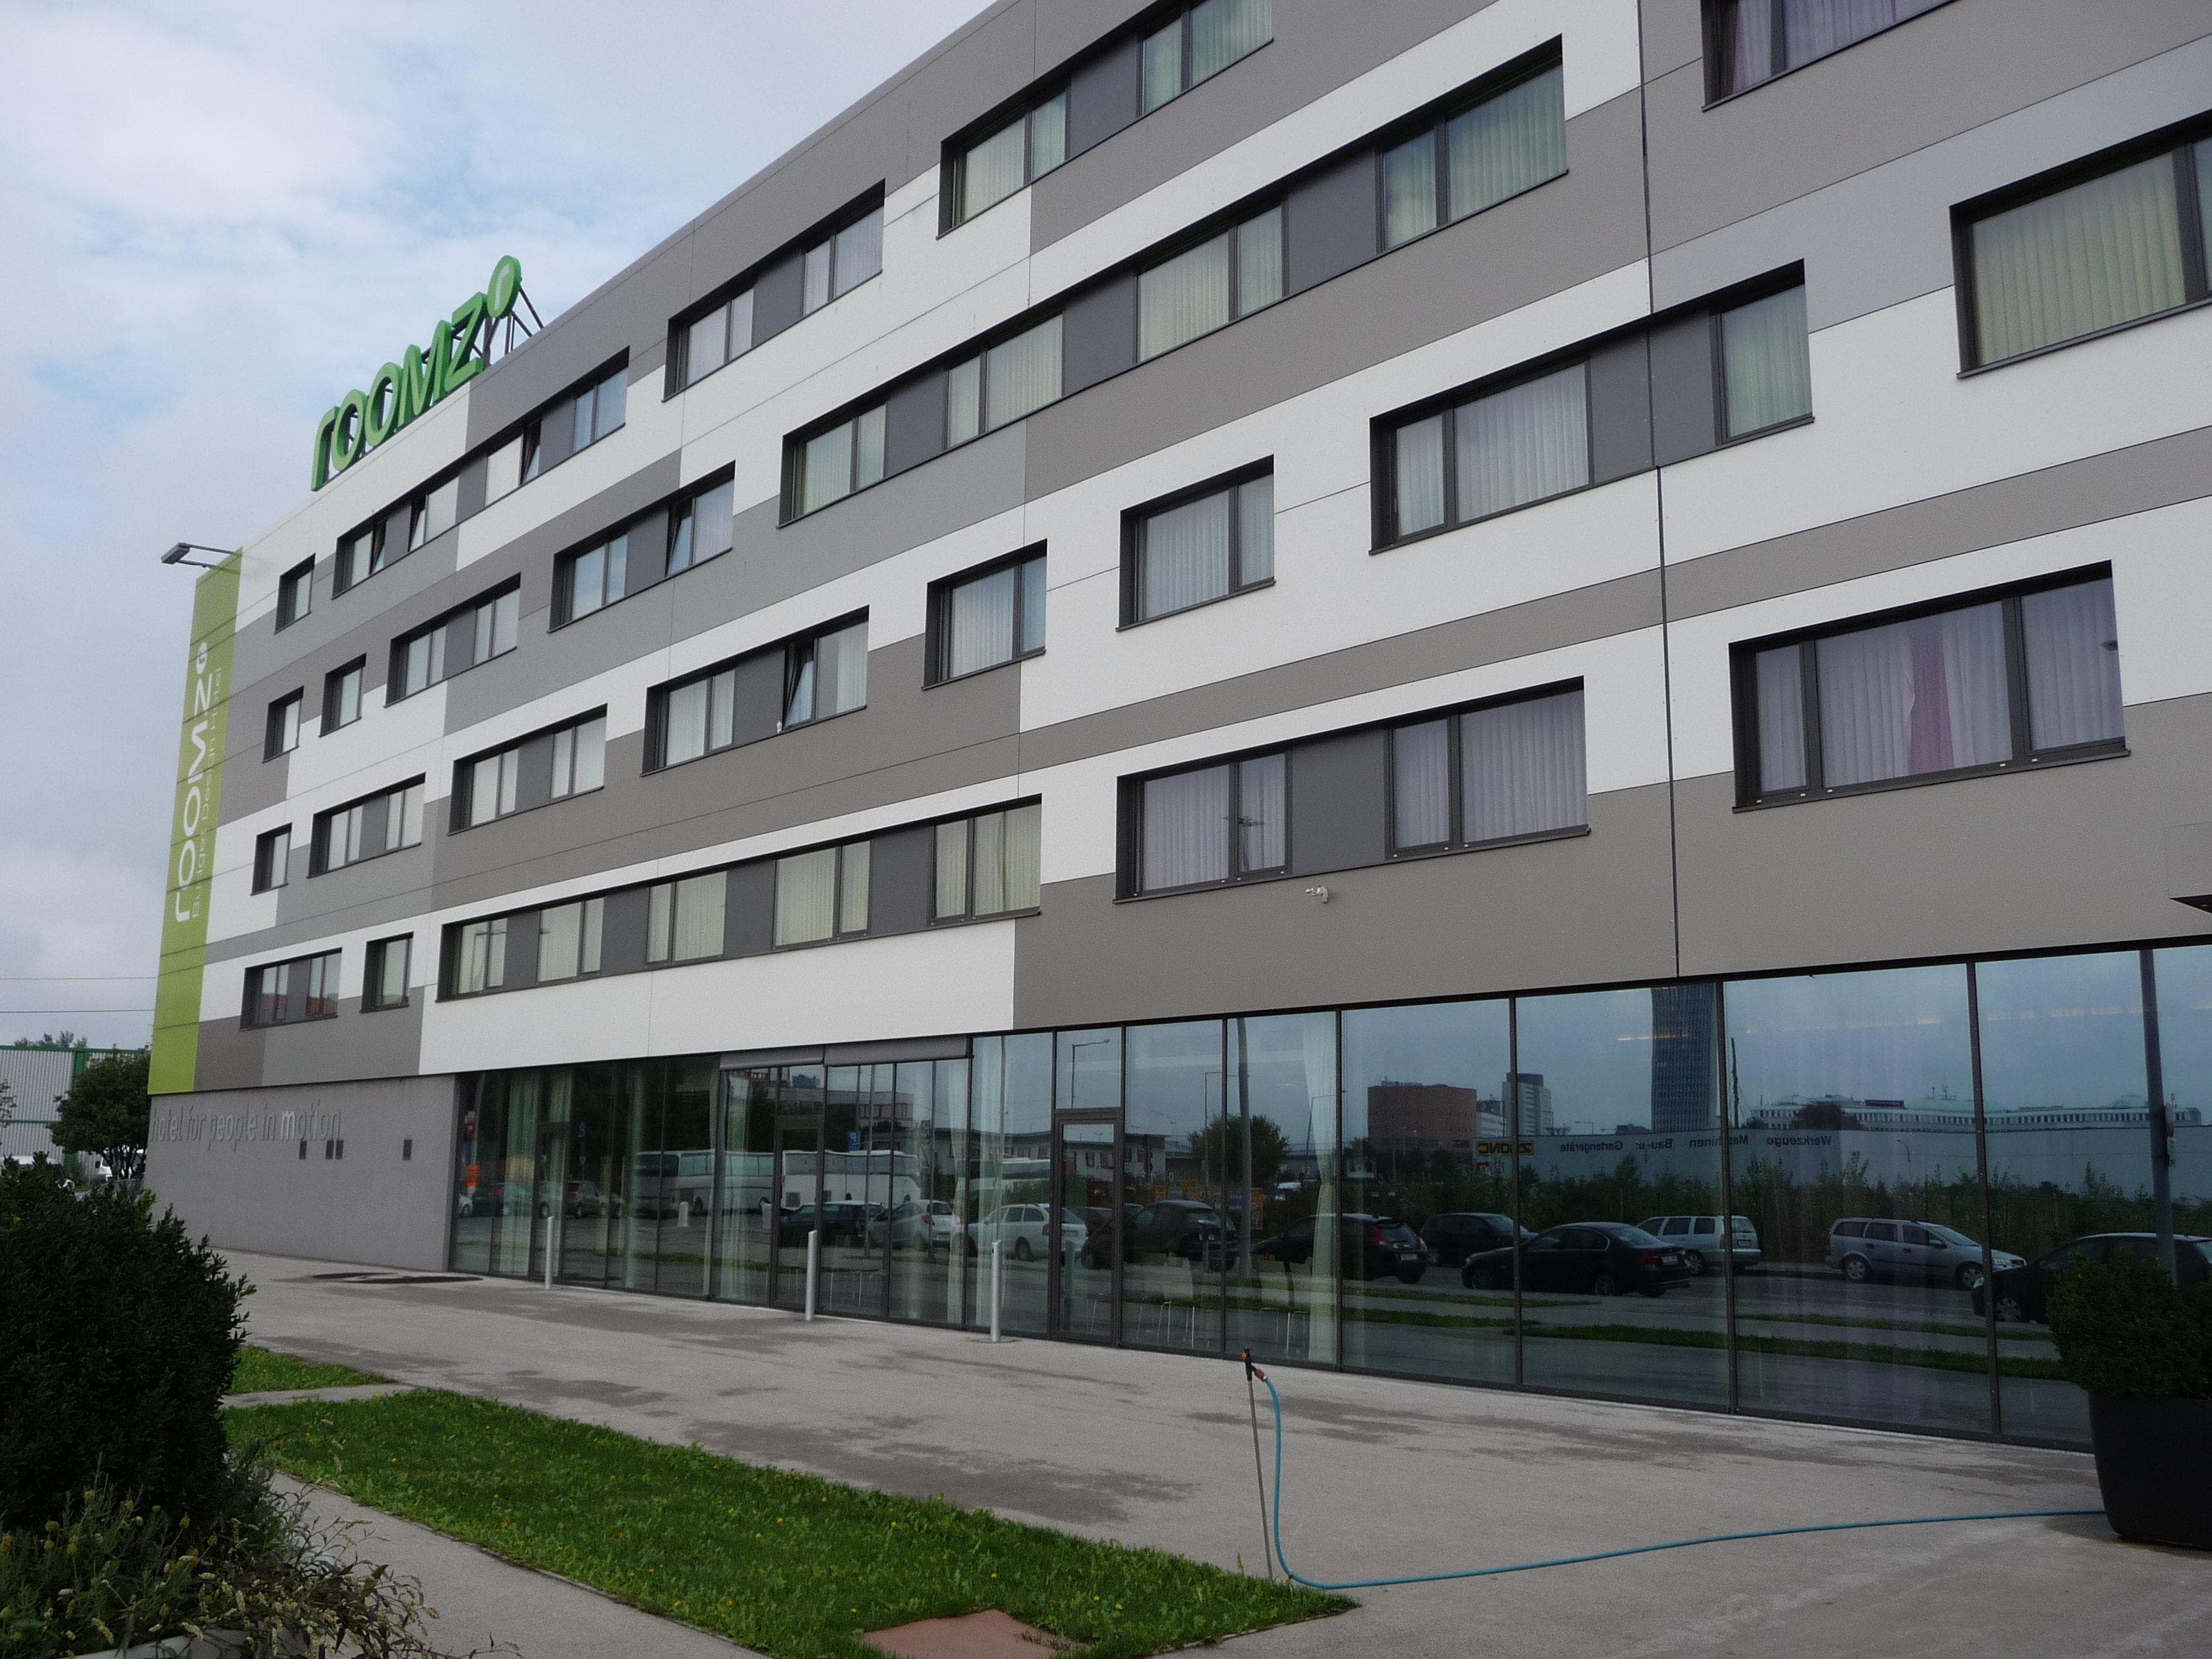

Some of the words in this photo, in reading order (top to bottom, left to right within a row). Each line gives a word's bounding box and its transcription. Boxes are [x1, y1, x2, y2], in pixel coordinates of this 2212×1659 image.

[150, 1105, 183, 1142] hotel
[188, 1105, 207, 1142] for
[208, 1103, 257, 1151] people
[262, 1102, 276, 1140] in
[280, 1098, 341, 1141] motion
